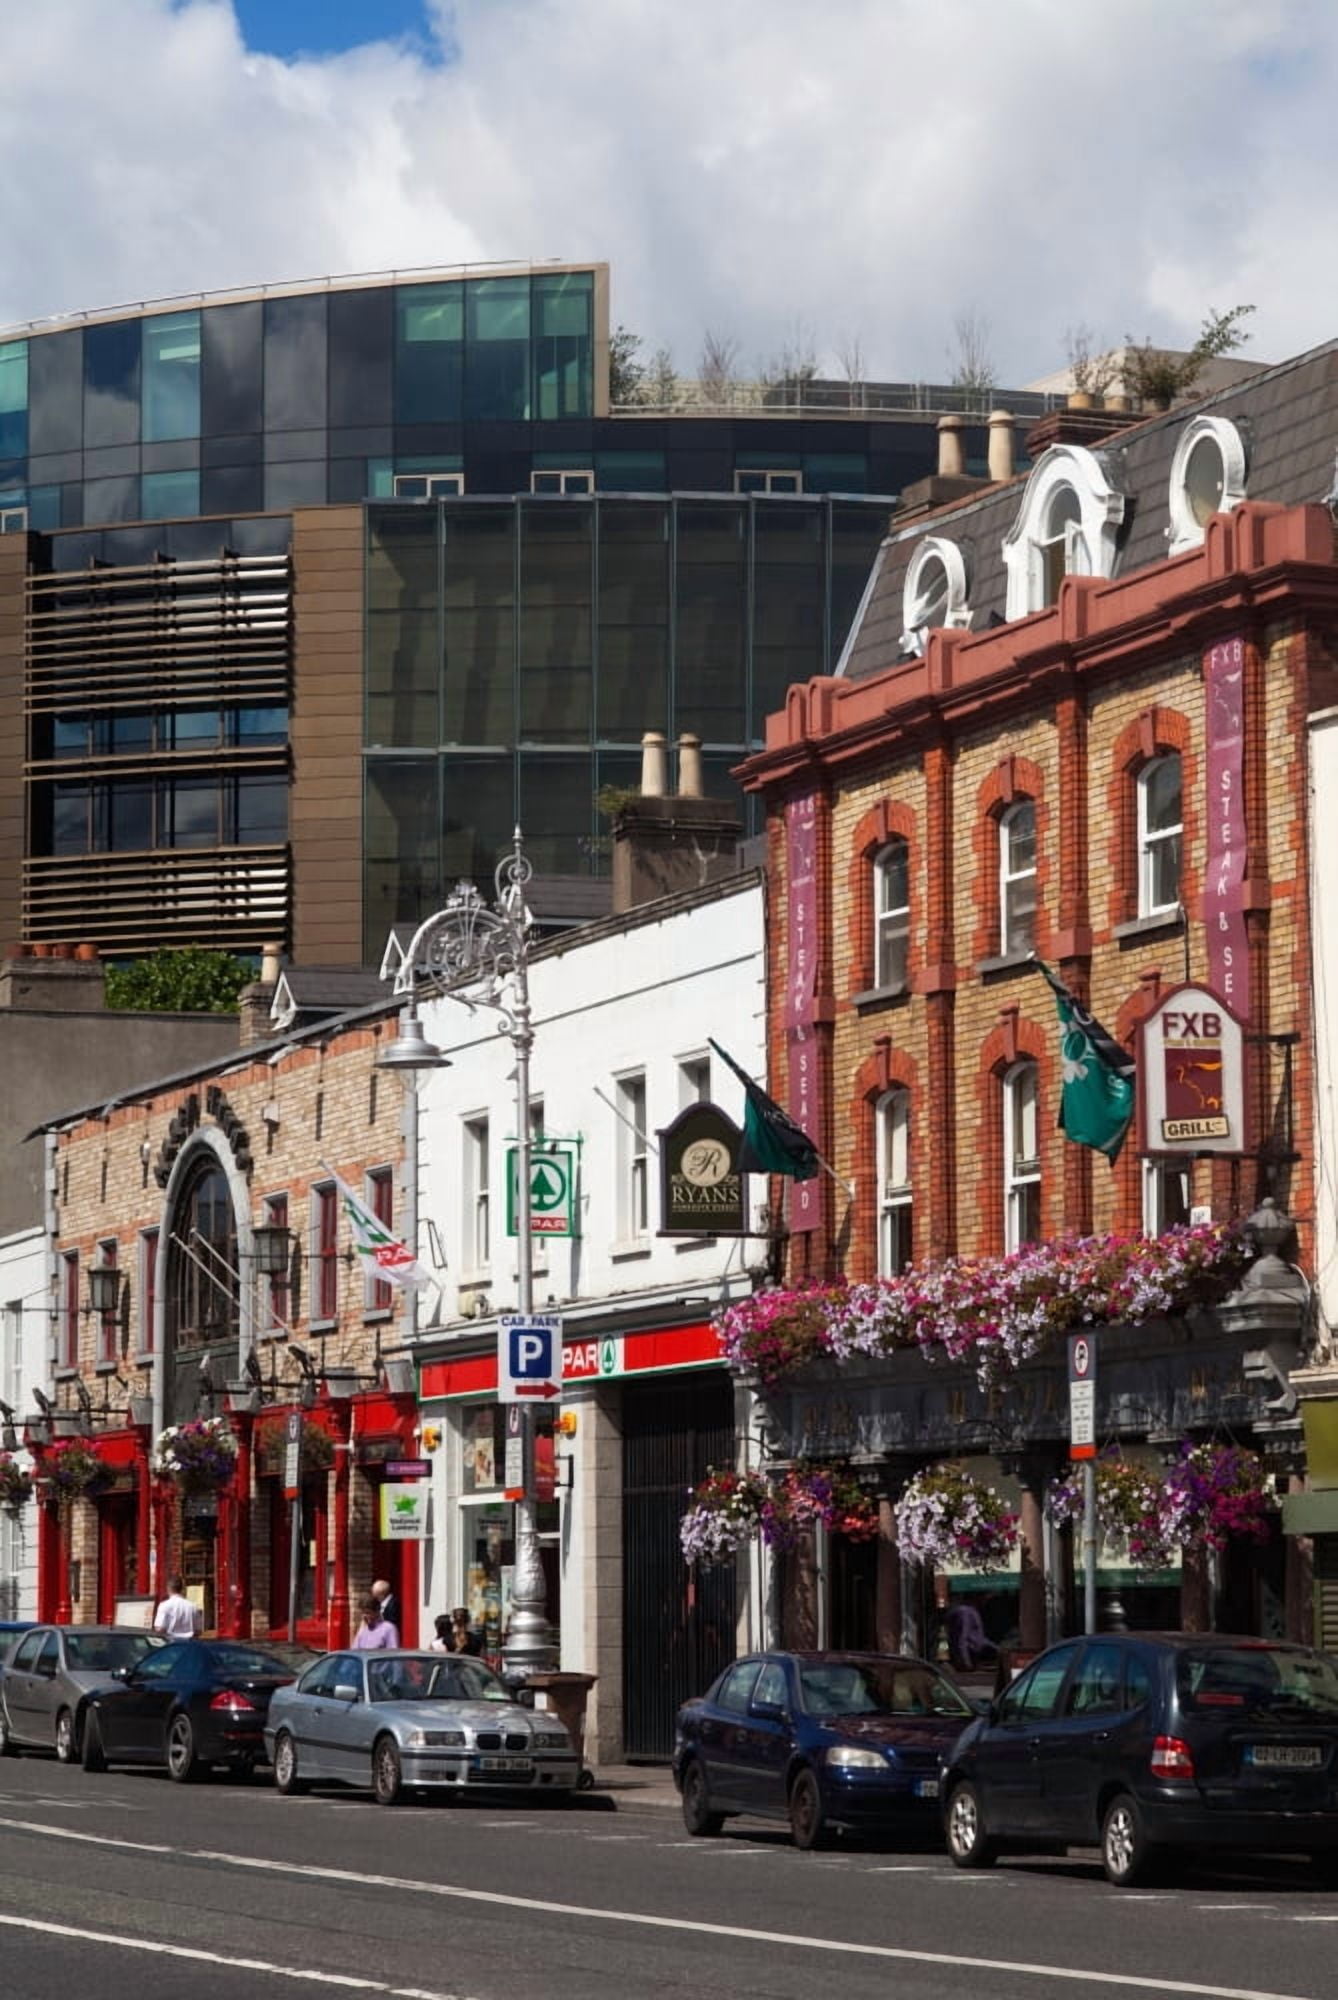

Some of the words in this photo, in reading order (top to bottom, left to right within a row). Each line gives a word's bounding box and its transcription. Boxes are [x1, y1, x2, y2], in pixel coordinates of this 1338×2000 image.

[1217, 769, 1232, 896] STEAK
[795, 903, 806, 1012] STEAK
[1161, 1012, 1222, 1038] FXB
[1167, 1121, 1215, 1137] GRILL
[672, 1186, 739, 1203] RYANS
[501, 1316, 526, 1327] CAR
[531, 1316, 560, 1327] PARK
[518, 1335, 544, 1373] P
[561, 1343, 599, 1373] PAR
